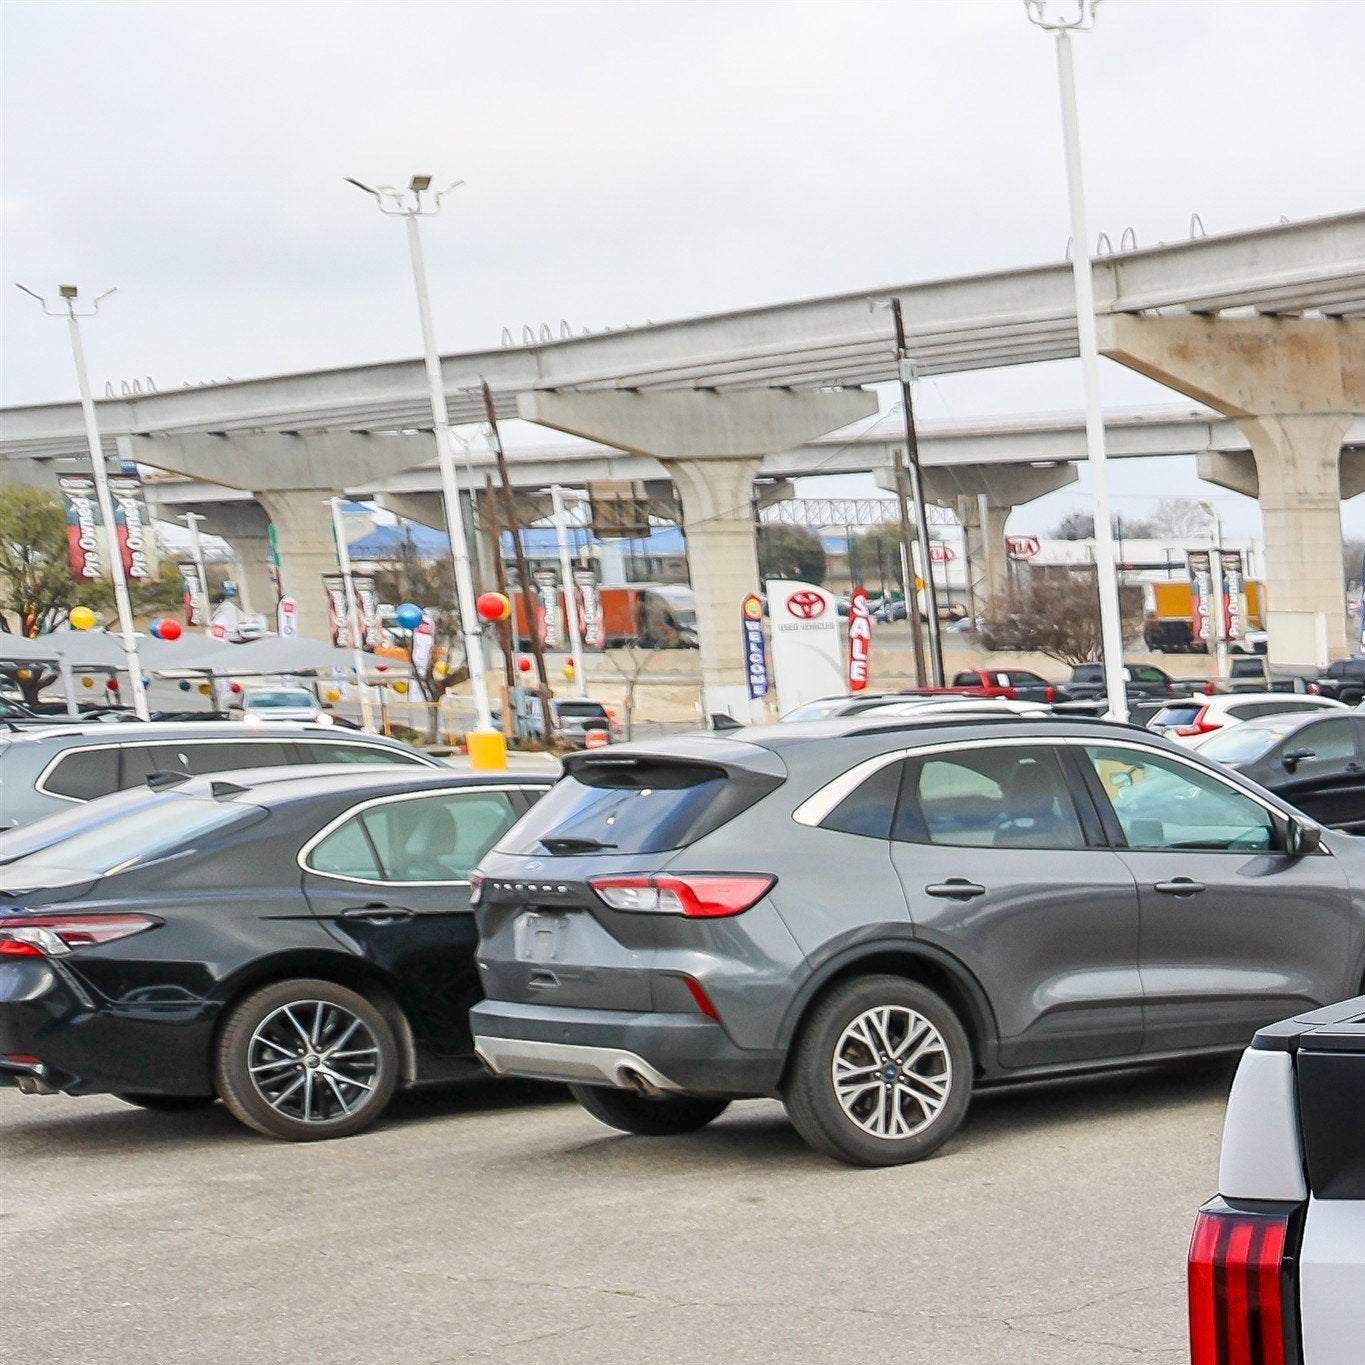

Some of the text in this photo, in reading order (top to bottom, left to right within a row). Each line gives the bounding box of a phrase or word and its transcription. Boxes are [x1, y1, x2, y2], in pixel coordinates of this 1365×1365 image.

[118, 498, 144, 550] Owned
[82, 551, 101, 577] Pre
[130, 551, 149, 577] Pre
[745, 620, 768, 695] WELCOME
[849, 594, 871, 681] SALE
